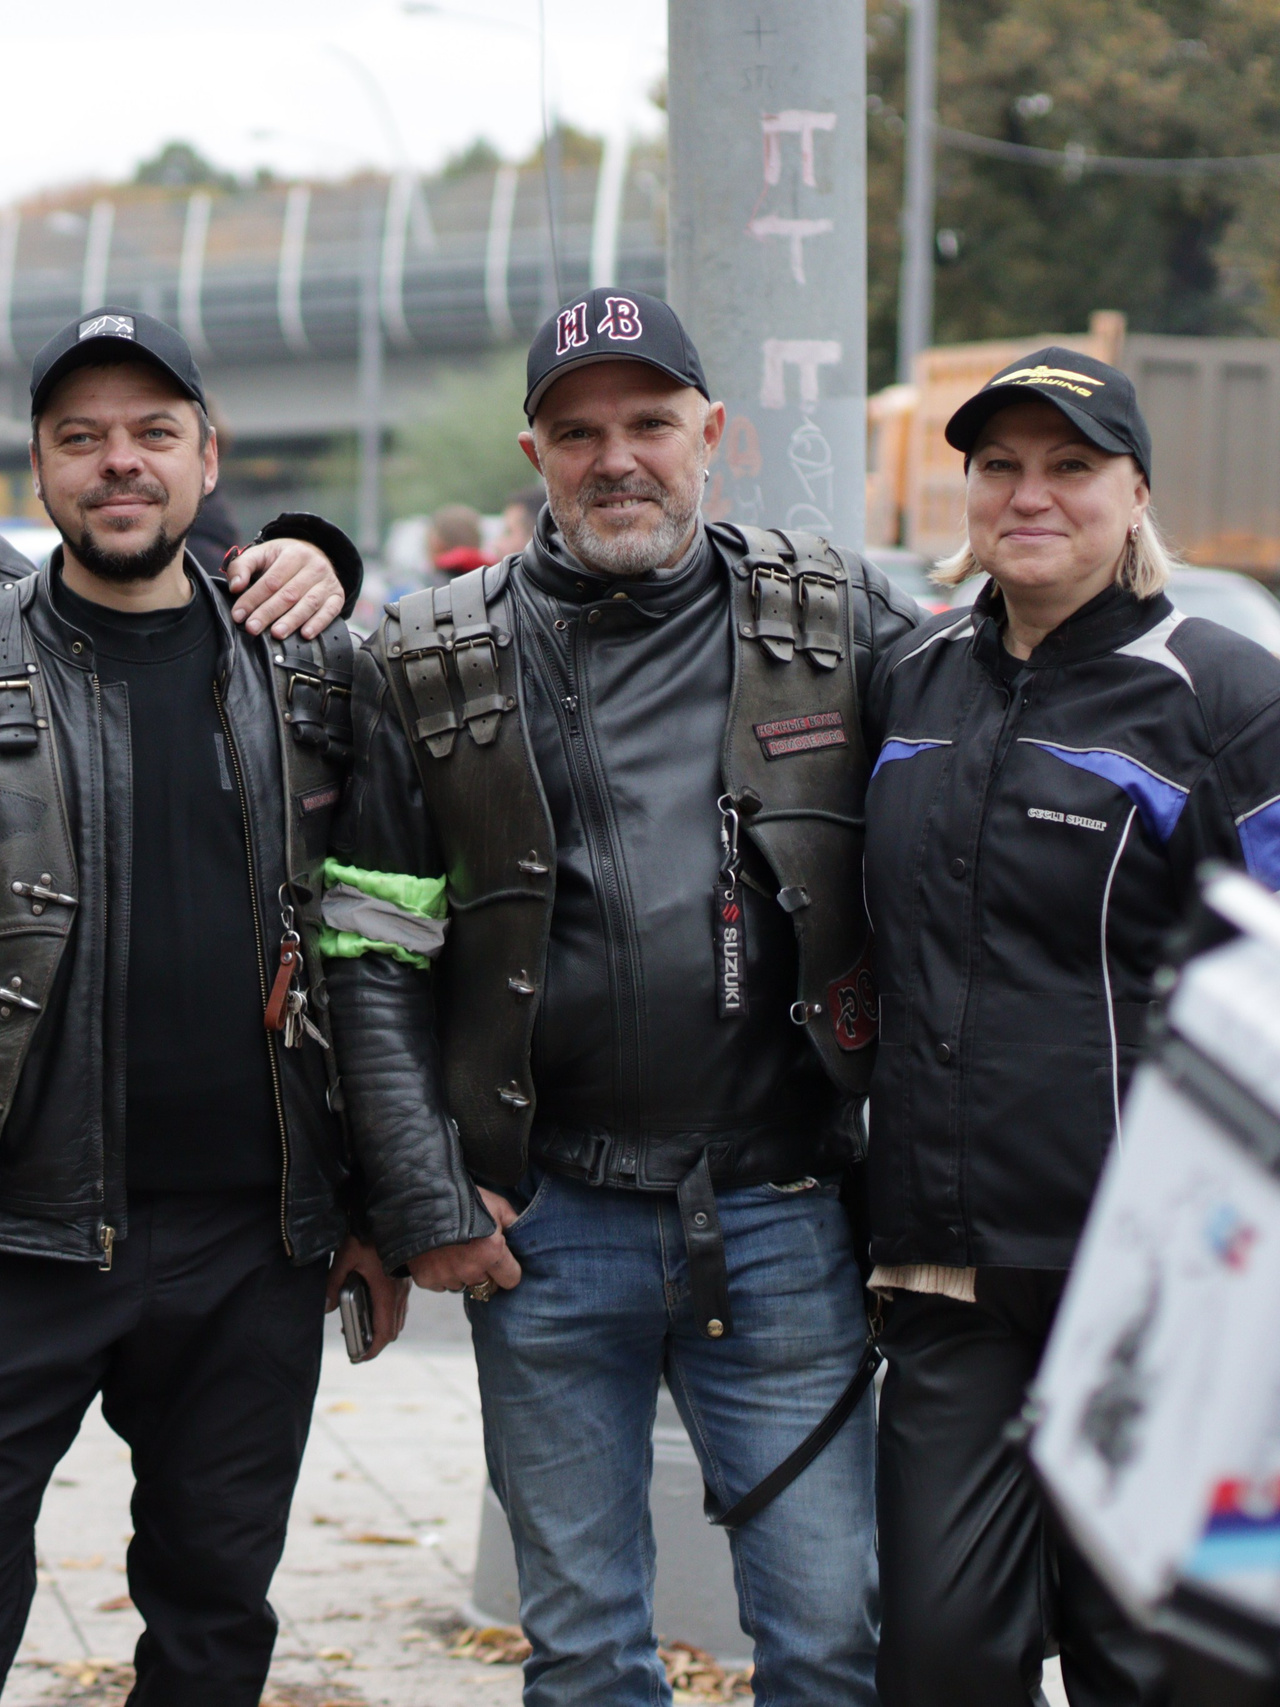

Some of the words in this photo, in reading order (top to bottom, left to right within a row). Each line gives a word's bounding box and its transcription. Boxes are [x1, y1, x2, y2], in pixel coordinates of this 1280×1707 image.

[1011, 377, 1092, 397] LDWING
[757, 718, 807, 738] НОЧНЫЕ
[770, 729, 846, 756] ДОМОДЕДОВО
[1027, 807, 1065, 823] CYCLE
[1065, 814, 1107, 832] SPIRIT
[723, 927, 740, 1009] SUZUKI
